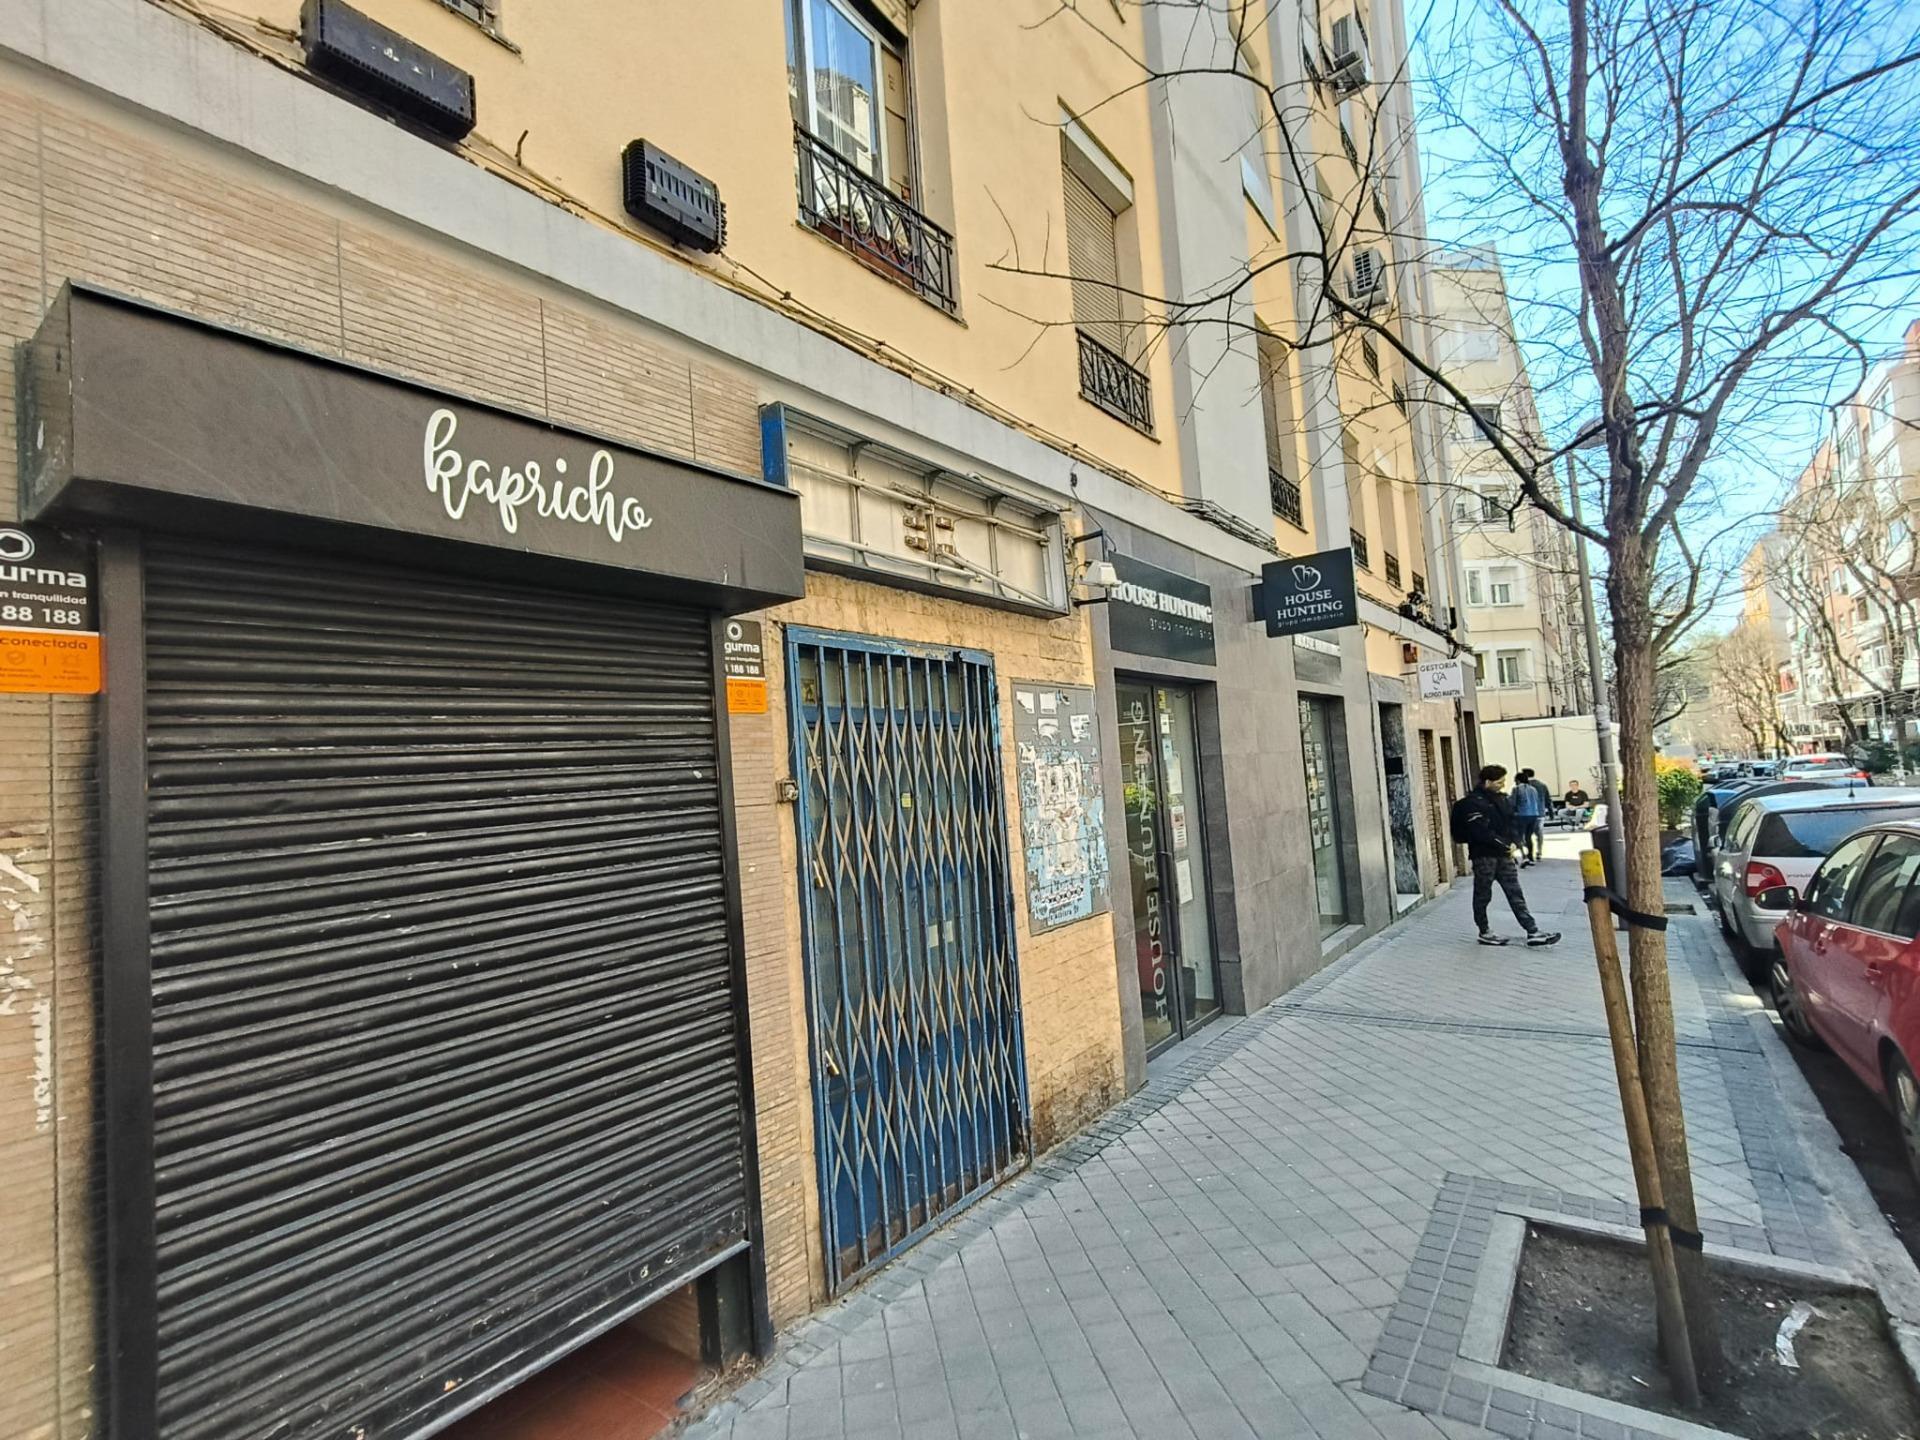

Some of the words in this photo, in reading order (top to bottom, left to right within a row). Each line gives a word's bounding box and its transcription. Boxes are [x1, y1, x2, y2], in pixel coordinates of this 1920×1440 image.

[424, 408, 653, 542] kapricho
[12, 590, 87, 605] tranquilidad
[1111, 582, 1158, 609] HOUSE
[1158, 592, 1213, 624] HUNTING
[1284, 589, 1332, 606] HOUSE
[42, 608, 81, 625] 188
[1277, 600, 1343, 620] HUNTING
[724, 642, 760, 653] gurma
[731, 663, 745, 674] 188
[746, 664, 760, 675] 188
[1146, 892, 1169, 1024] HOUSE
